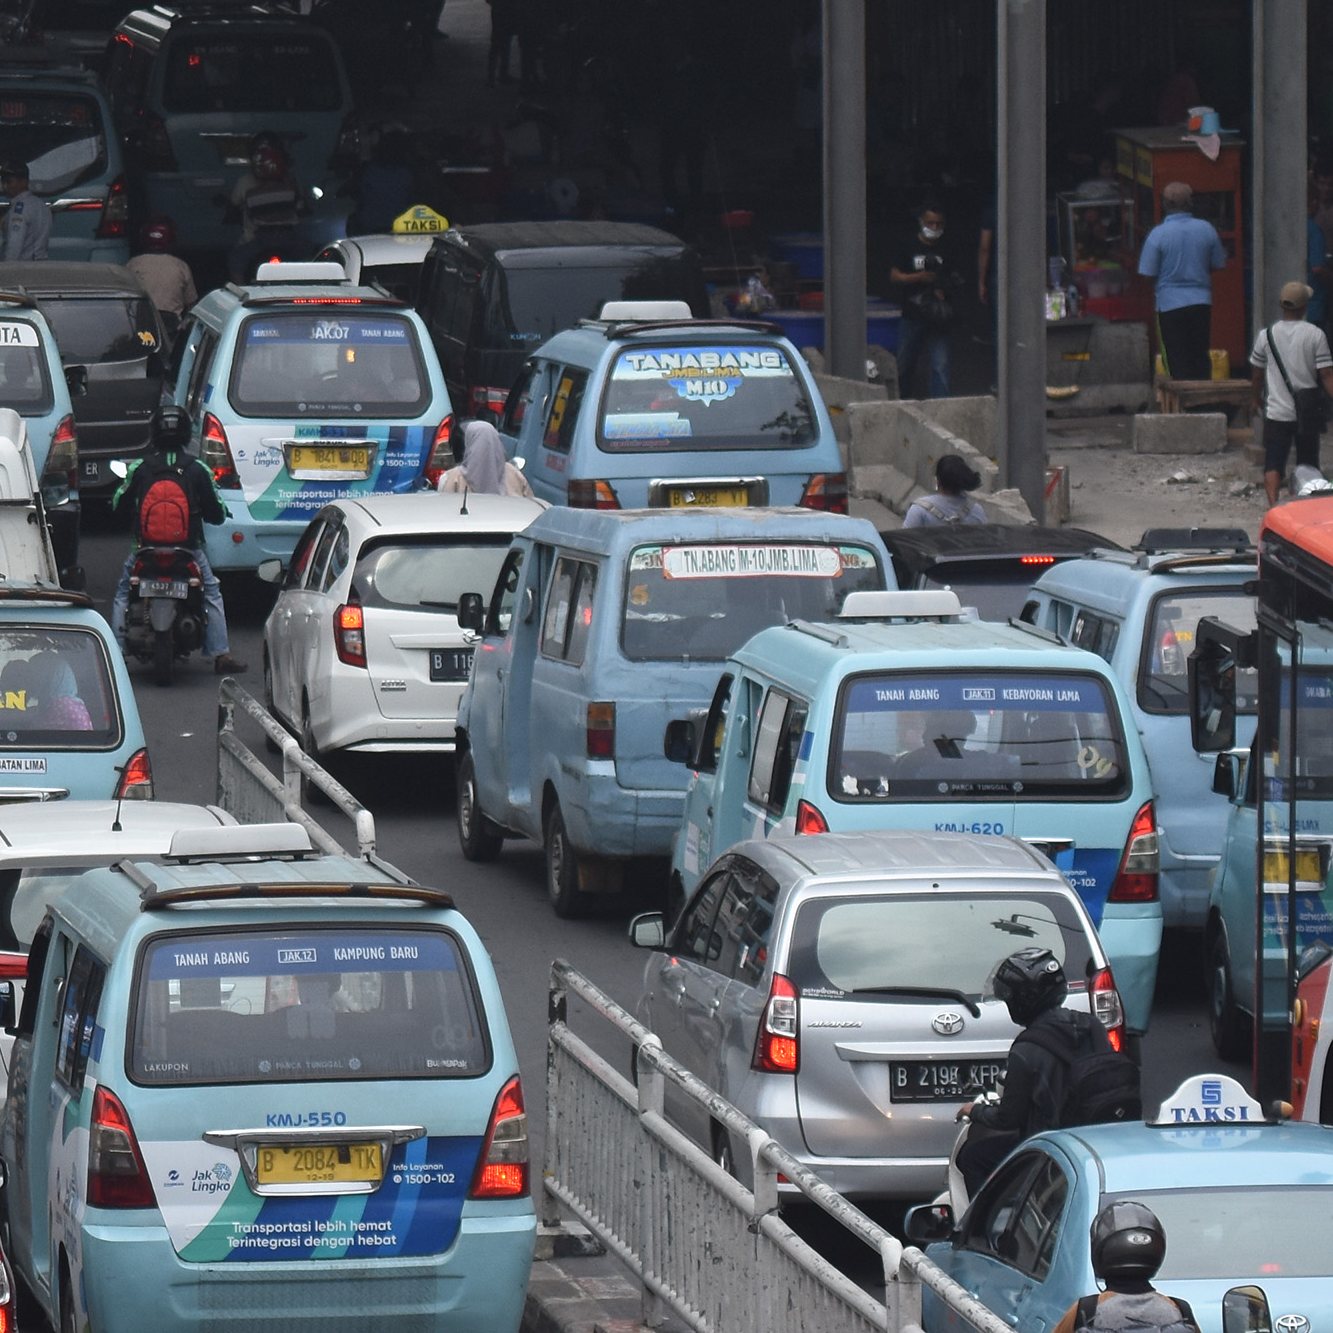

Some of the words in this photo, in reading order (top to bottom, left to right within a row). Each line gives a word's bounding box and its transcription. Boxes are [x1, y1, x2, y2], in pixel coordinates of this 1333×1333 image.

[403, 220, 441, 231] TAKSI
[361, 329, 382, 337] TANAH
[383, 329, 405, 338] ABANG
[626, 351, 783, 371] TANABANG
[686, 379, 728, 396] M10
[294, 450, 301, 463] B
[386, 459, 420, 467] 1500-102
[278, 489, 336, 499] Transportasi
[337, 489, 362, 498] lebih
[683, 550, 736, 573] TN.ABANG
[739, 549, 766, 571] M-10
[766, 548, 819, 572] JMB.LIMA
[434, 654, 443, 670] B
[876, 690, 905, 701] TANAH
[909, 689, 940, 700] ABANG
[1002, 689, 1054, 701] KEBAYORAN
[1057, 690, 1081, 702] LAMA
[24, 759, 45, 771] LIMA
[174, 952, 209, 966] TANAH
[213, 951, 250, 965] ABANG
[283, 950, 313, 962] JAK.12
[334, 947, 385, 961] KAMPUNG
[390, 946, 419, 959] BARU
[144, 1062, 190, 1072] LAKUPON
[898, 1068, 908, 1087] B
[266, 1112, 347, 1128] KMJ-550
[1170, 1105, 1250, 1122] TAKSI
[263, 1151, 274, 1172] B
[294, 1149, 336, 1171] 2084
[358, 1148, 376, 1170] TK
[192, 1169, 213, 1181] Jak
[393, 1163, 409, 1171] Info
[410, 1163, 444, 1173] Layanan
[405, 1173, 456, 1185] 1500-102
[192, 1180, 231, 1194] Lingko
[232, 1221, 313, 1237] Transportasi
[314, 1220, 348, 1233] lebih
[349, 1220, 393, 1233] hemat
[228, 1236, 303, 1251] Terintegrasi
[304, 1235, 357, 1250] dengan
[357, 1234, 397, 1247] hebat
